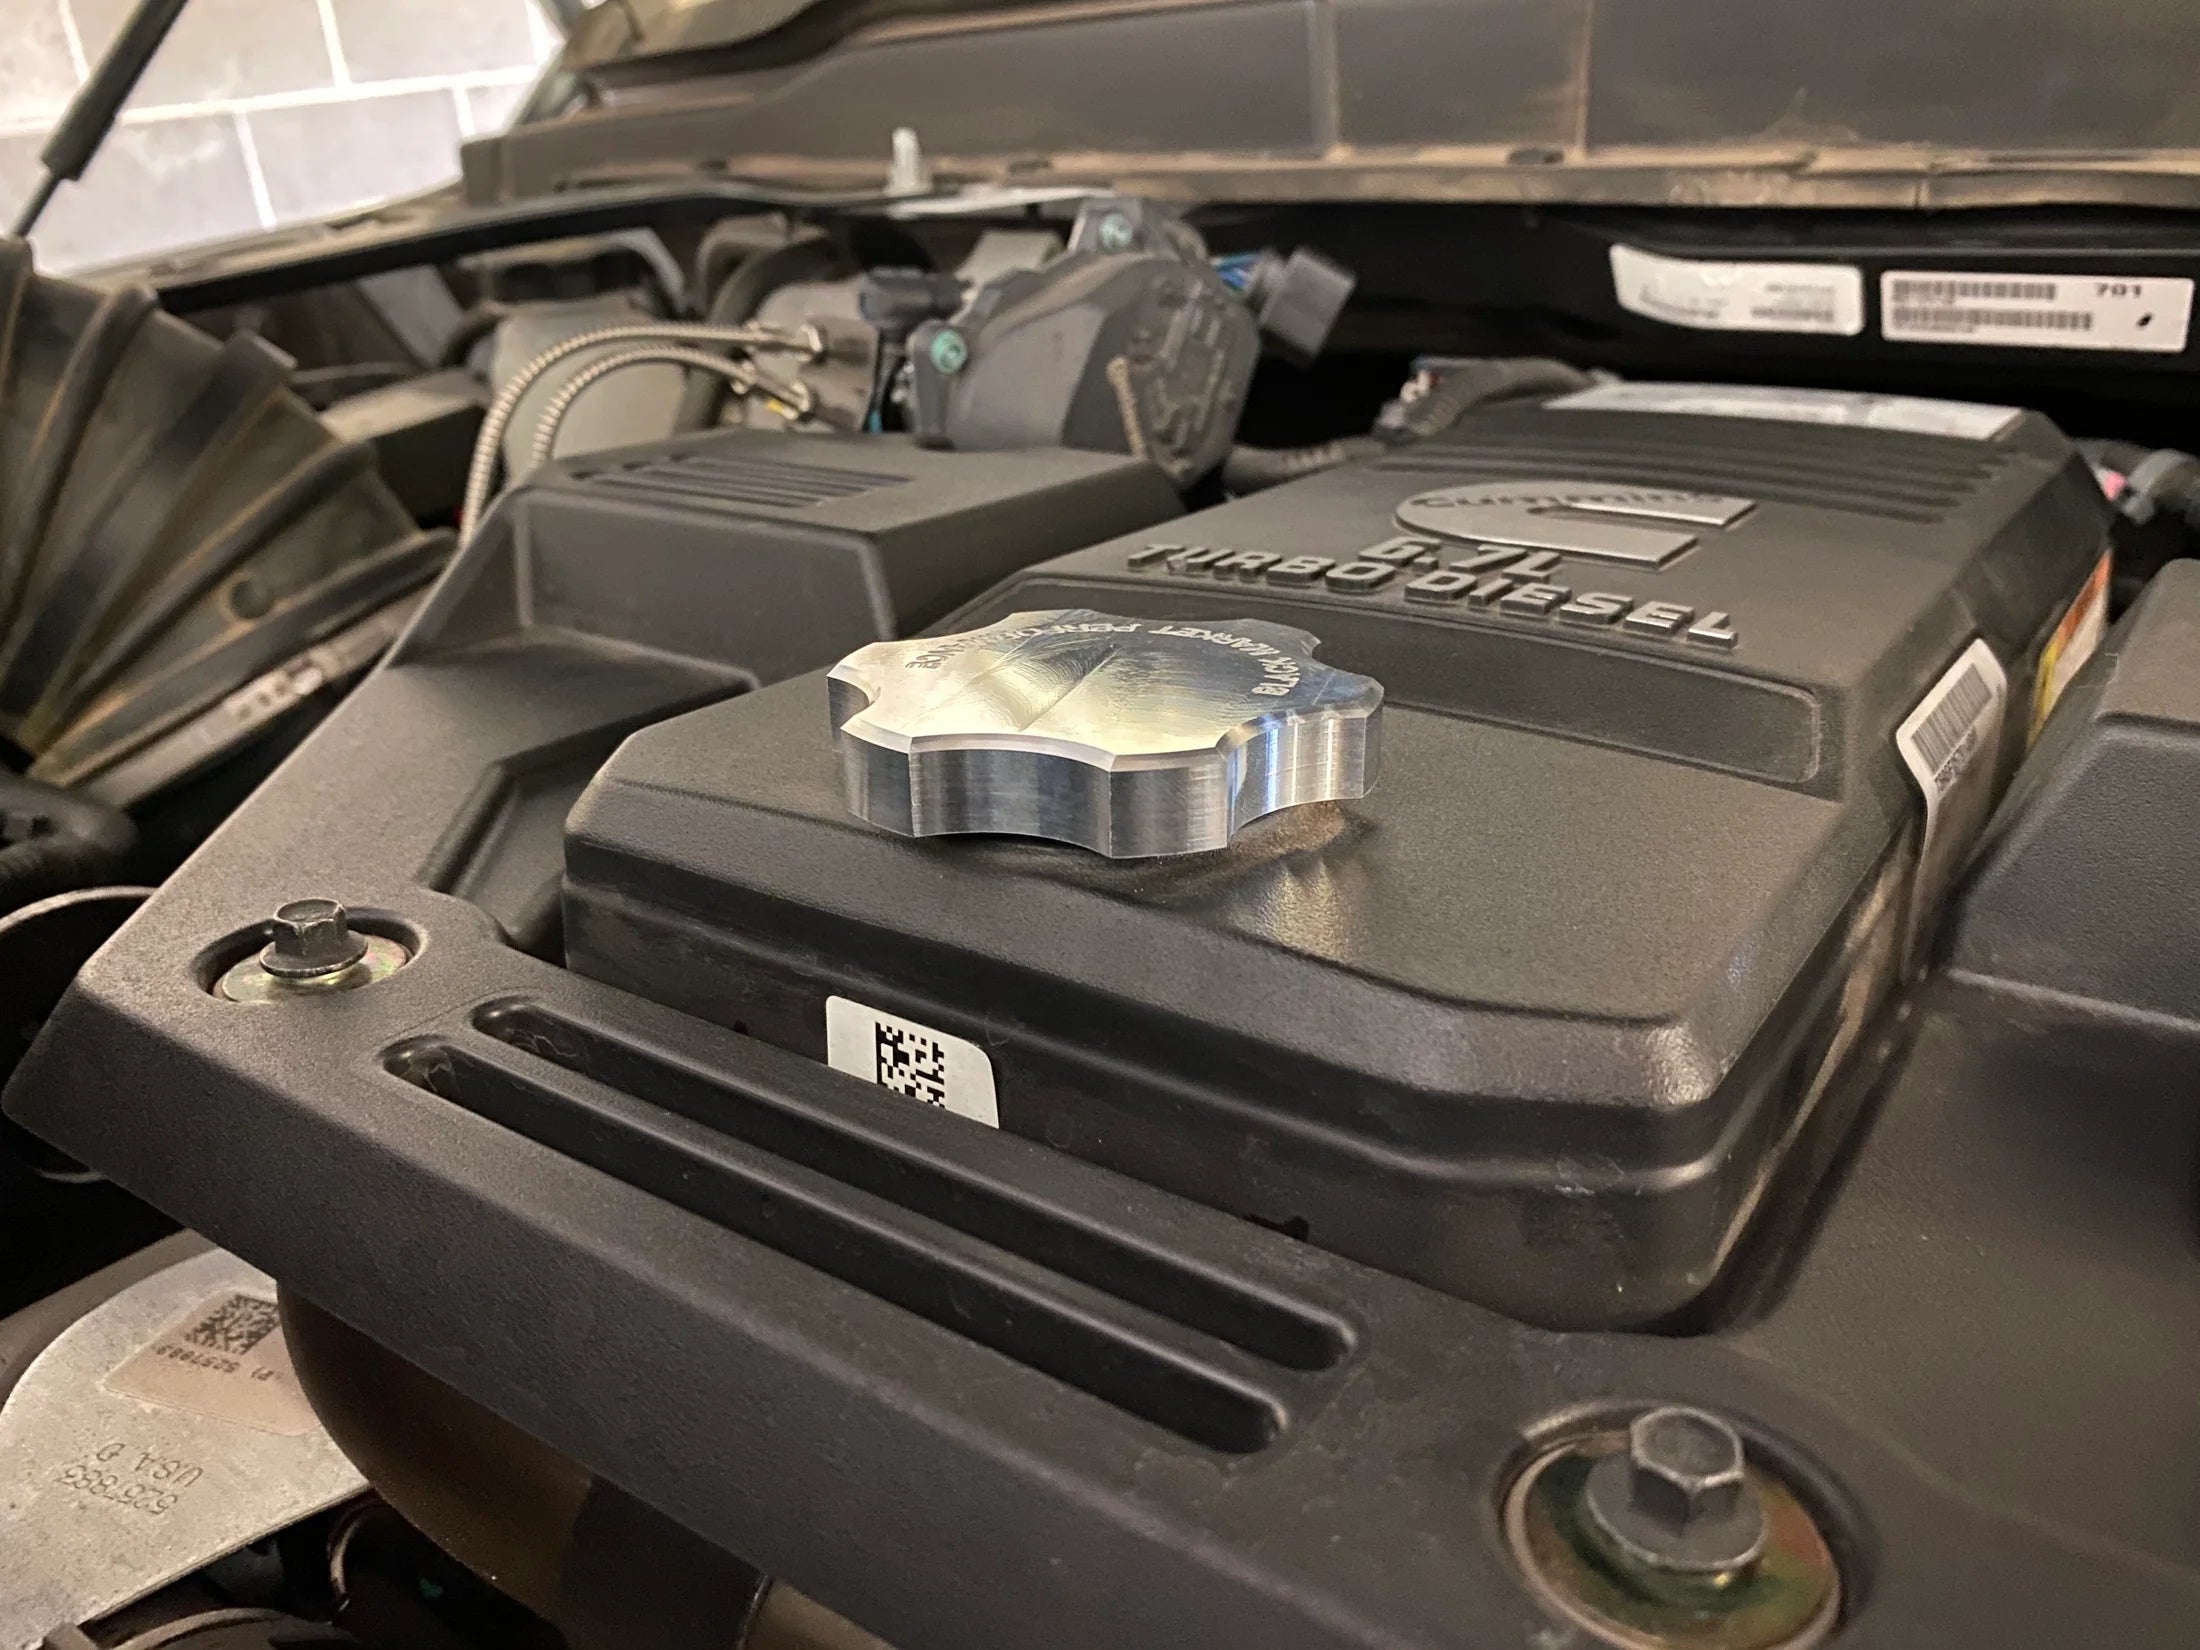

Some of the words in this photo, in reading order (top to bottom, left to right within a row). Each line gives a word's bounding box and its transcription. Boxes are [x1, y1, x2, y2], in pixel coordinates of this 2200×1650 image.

[1357, 535, 1563, 585] 6.7L
[1126, 543, 1398, 594] TURBO
[1404, 571, 1738, 648] DIESEL
[905, 622, 1143, 670] PERFORANCE
[1148, 625, 1281, 656] MARKET
[1251, 656, 1301, 696] BLACK
